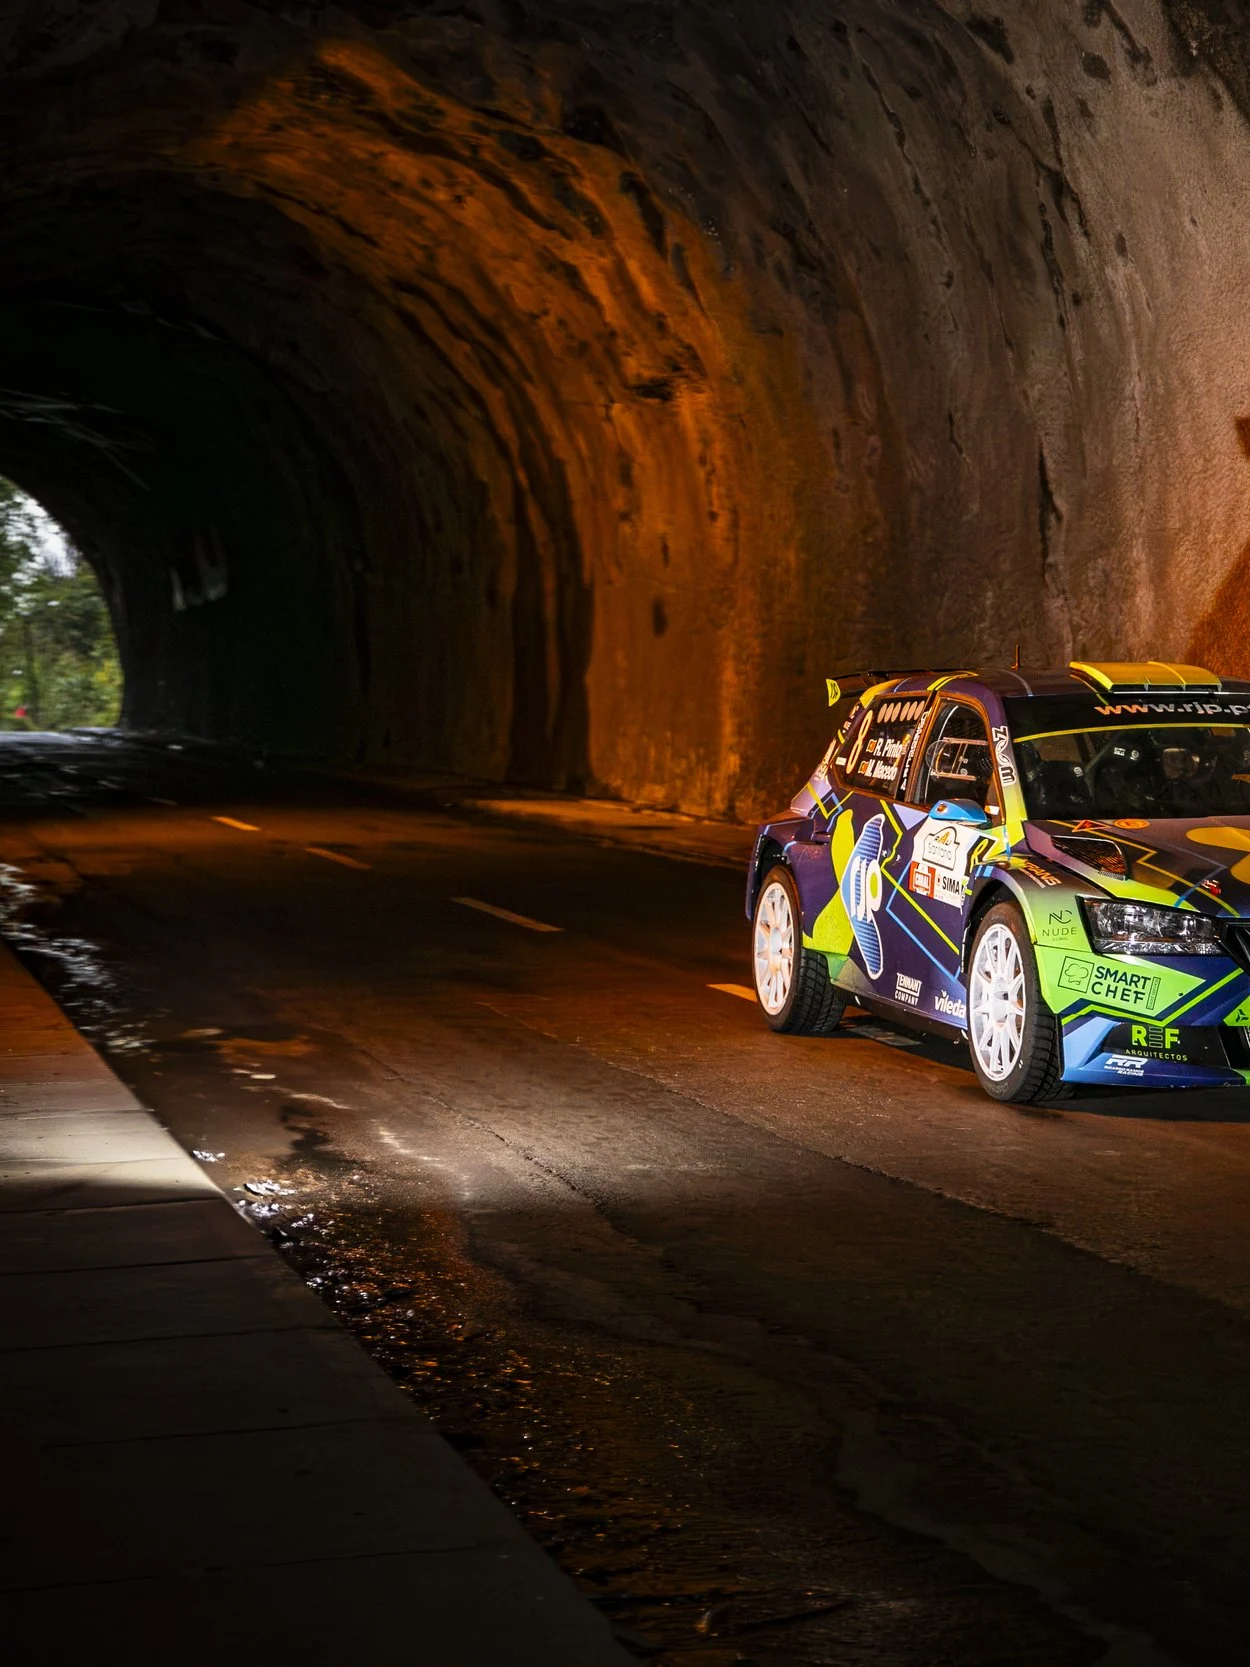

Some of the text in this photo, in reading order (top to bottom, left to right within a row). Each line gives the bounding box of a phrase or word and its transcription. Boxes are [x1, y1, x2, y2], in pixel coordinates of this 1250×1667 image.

[846, 709, 873, 774] 8
[1042, 927, 1077, 937] NUDE
[1094, 966, 1151, 989] SMART
[894, 990, 919, 1006] COMPANY
[934, 990, 967, 1018] vileda
[1091, 981, 1145, 1004] CHEF
[1126, 1049, 1188, 1062] ARQUITECTOS
